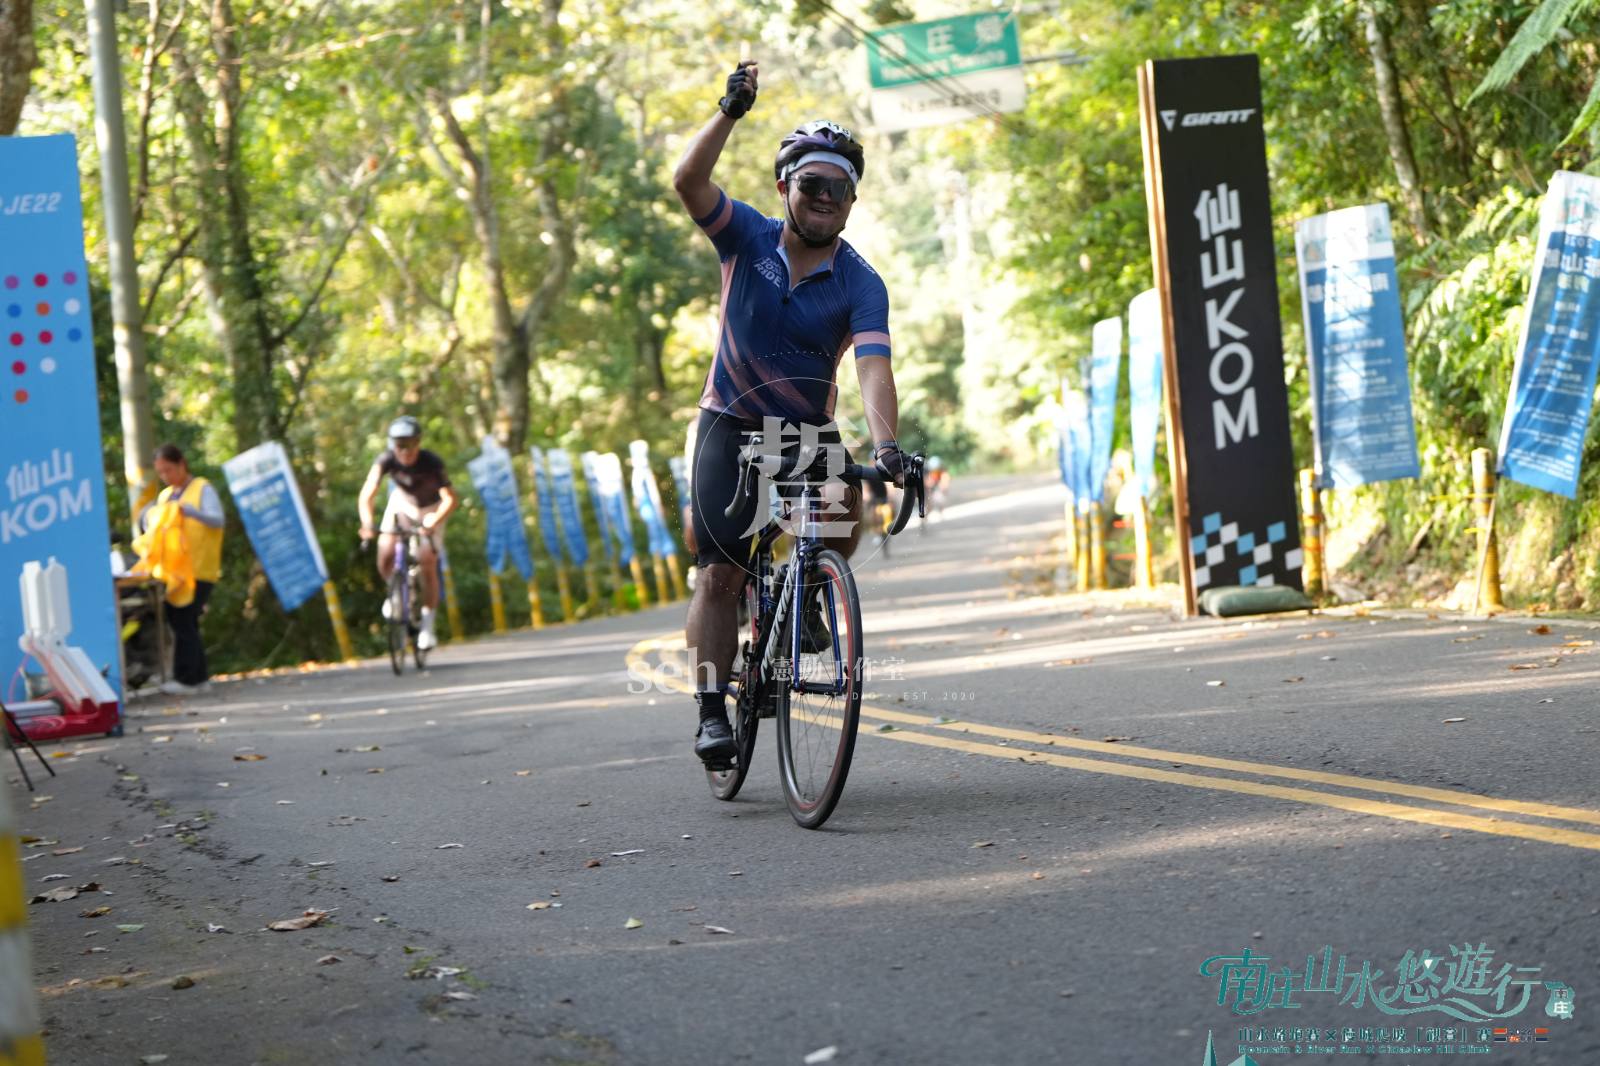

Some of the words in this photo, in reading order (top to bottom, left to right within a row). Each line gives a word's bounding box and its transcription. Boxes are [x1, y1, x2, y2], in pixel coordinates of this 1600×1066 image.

[1181, 109, 1257, 128] GIANT
[0, 191, 62, 215] JE22
[6, 448, 73, 502] 仙山
[1, 478, 92, 544] KOM
